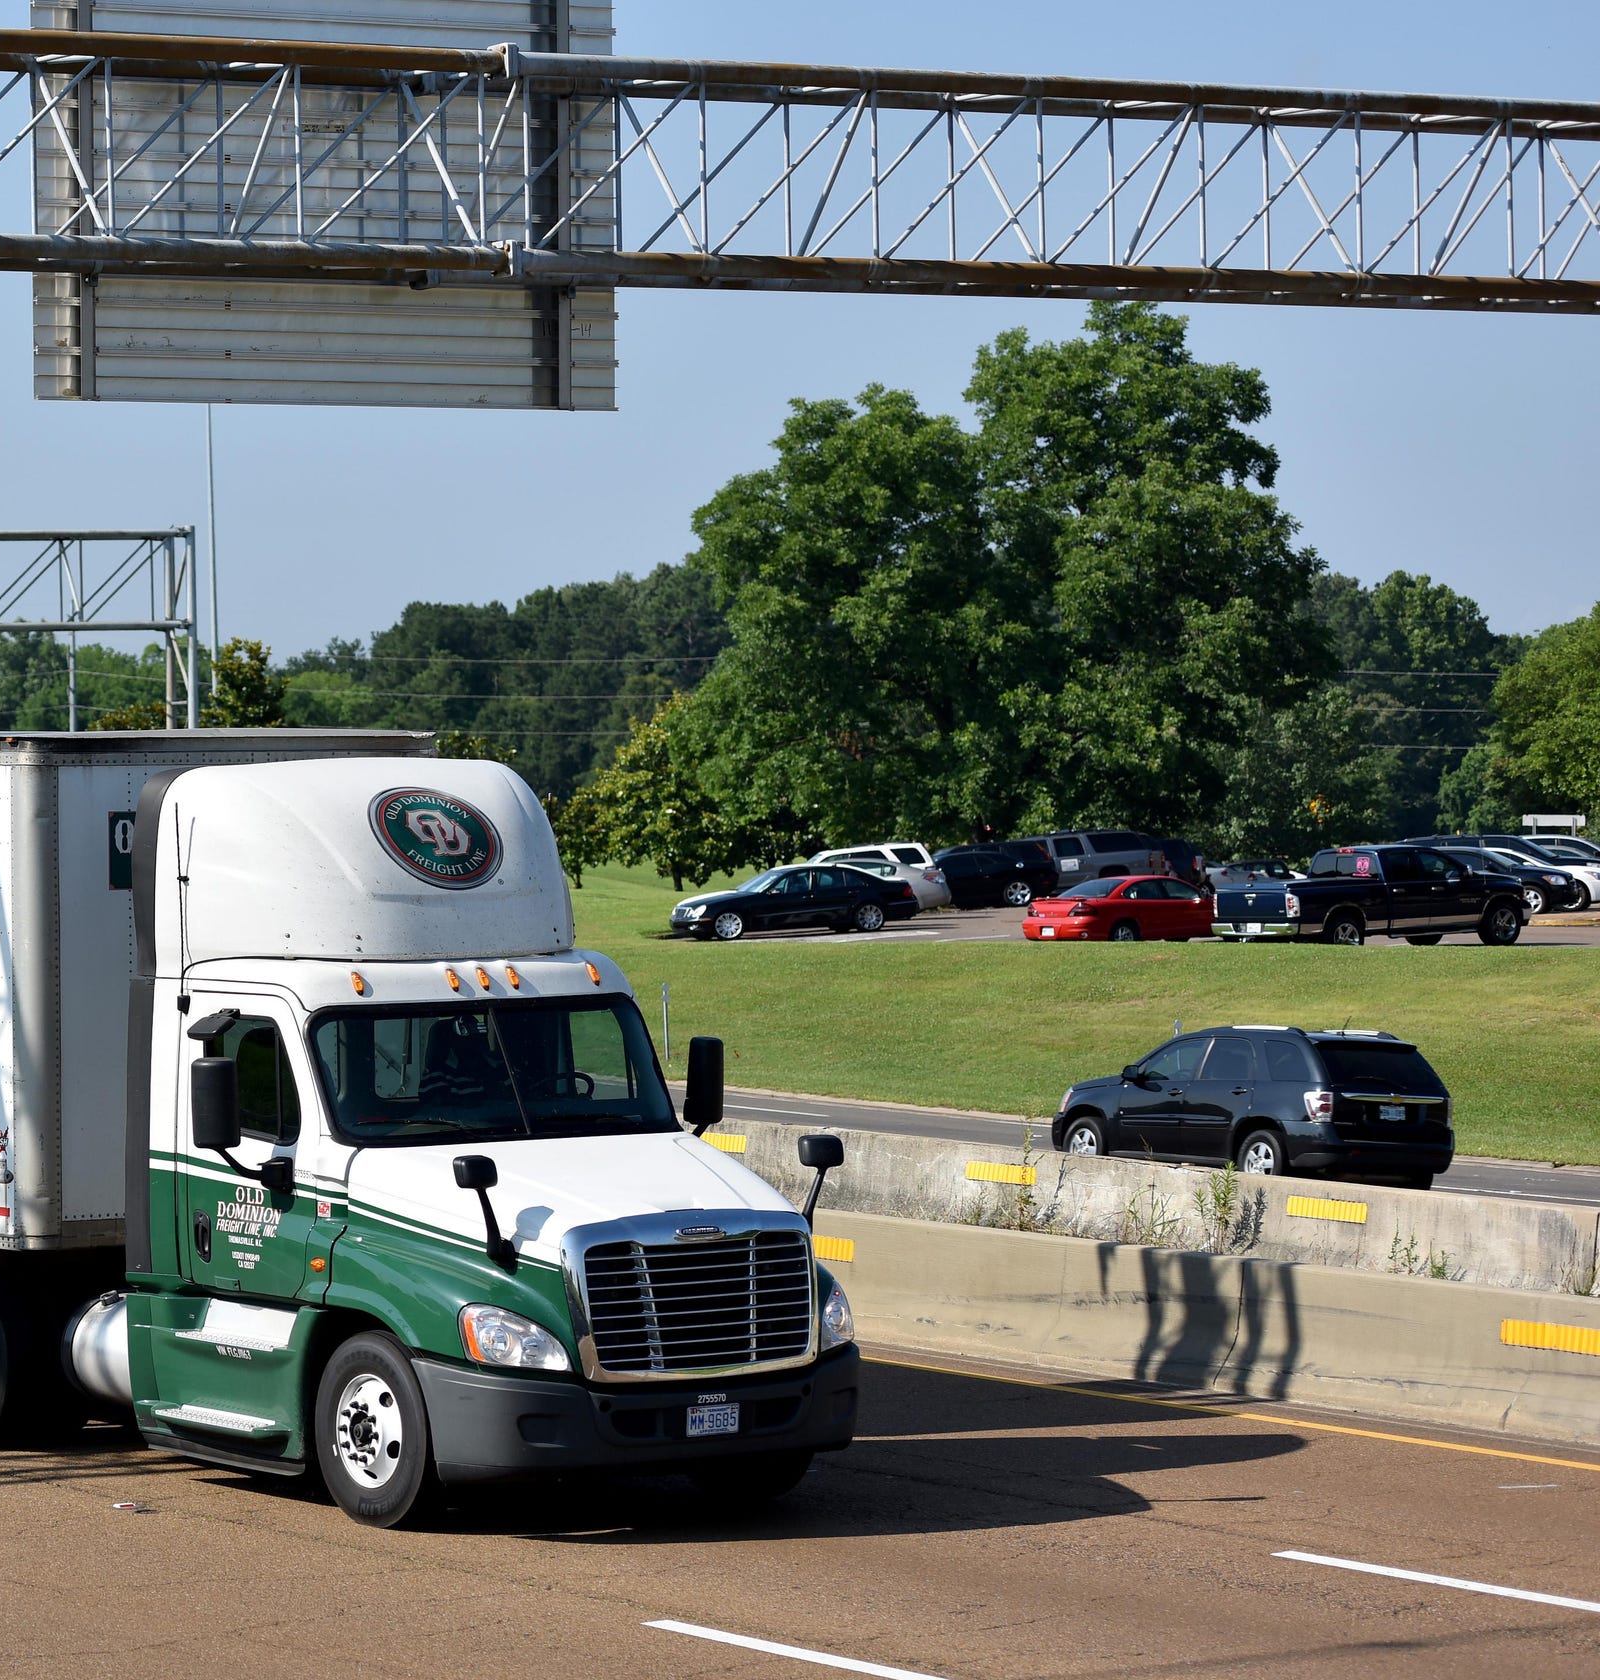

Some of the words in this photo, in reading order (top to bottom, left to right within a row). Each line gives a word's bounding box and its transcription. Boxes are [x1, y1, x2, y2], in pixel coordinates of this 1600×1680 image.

[386, 802, 403, 820] OLD
[401, 795, 471, 819] DOMINION
[406, 849, 464, 875] FREIGHT
[465, 848, 487, 871] LINE
[235, 1186, 264, 1205] OLD
[217, 1201, 282, 1225] DOMINION
[216, 1219, 246, 1233] FREIGHT
[244, 1221, 261, 1238] LINE,
[262, 1224, 278, 1238] INC.
[698, 1393, 726, 1403] 2755570
[690, 1411, 737, 1430] MM-9685
